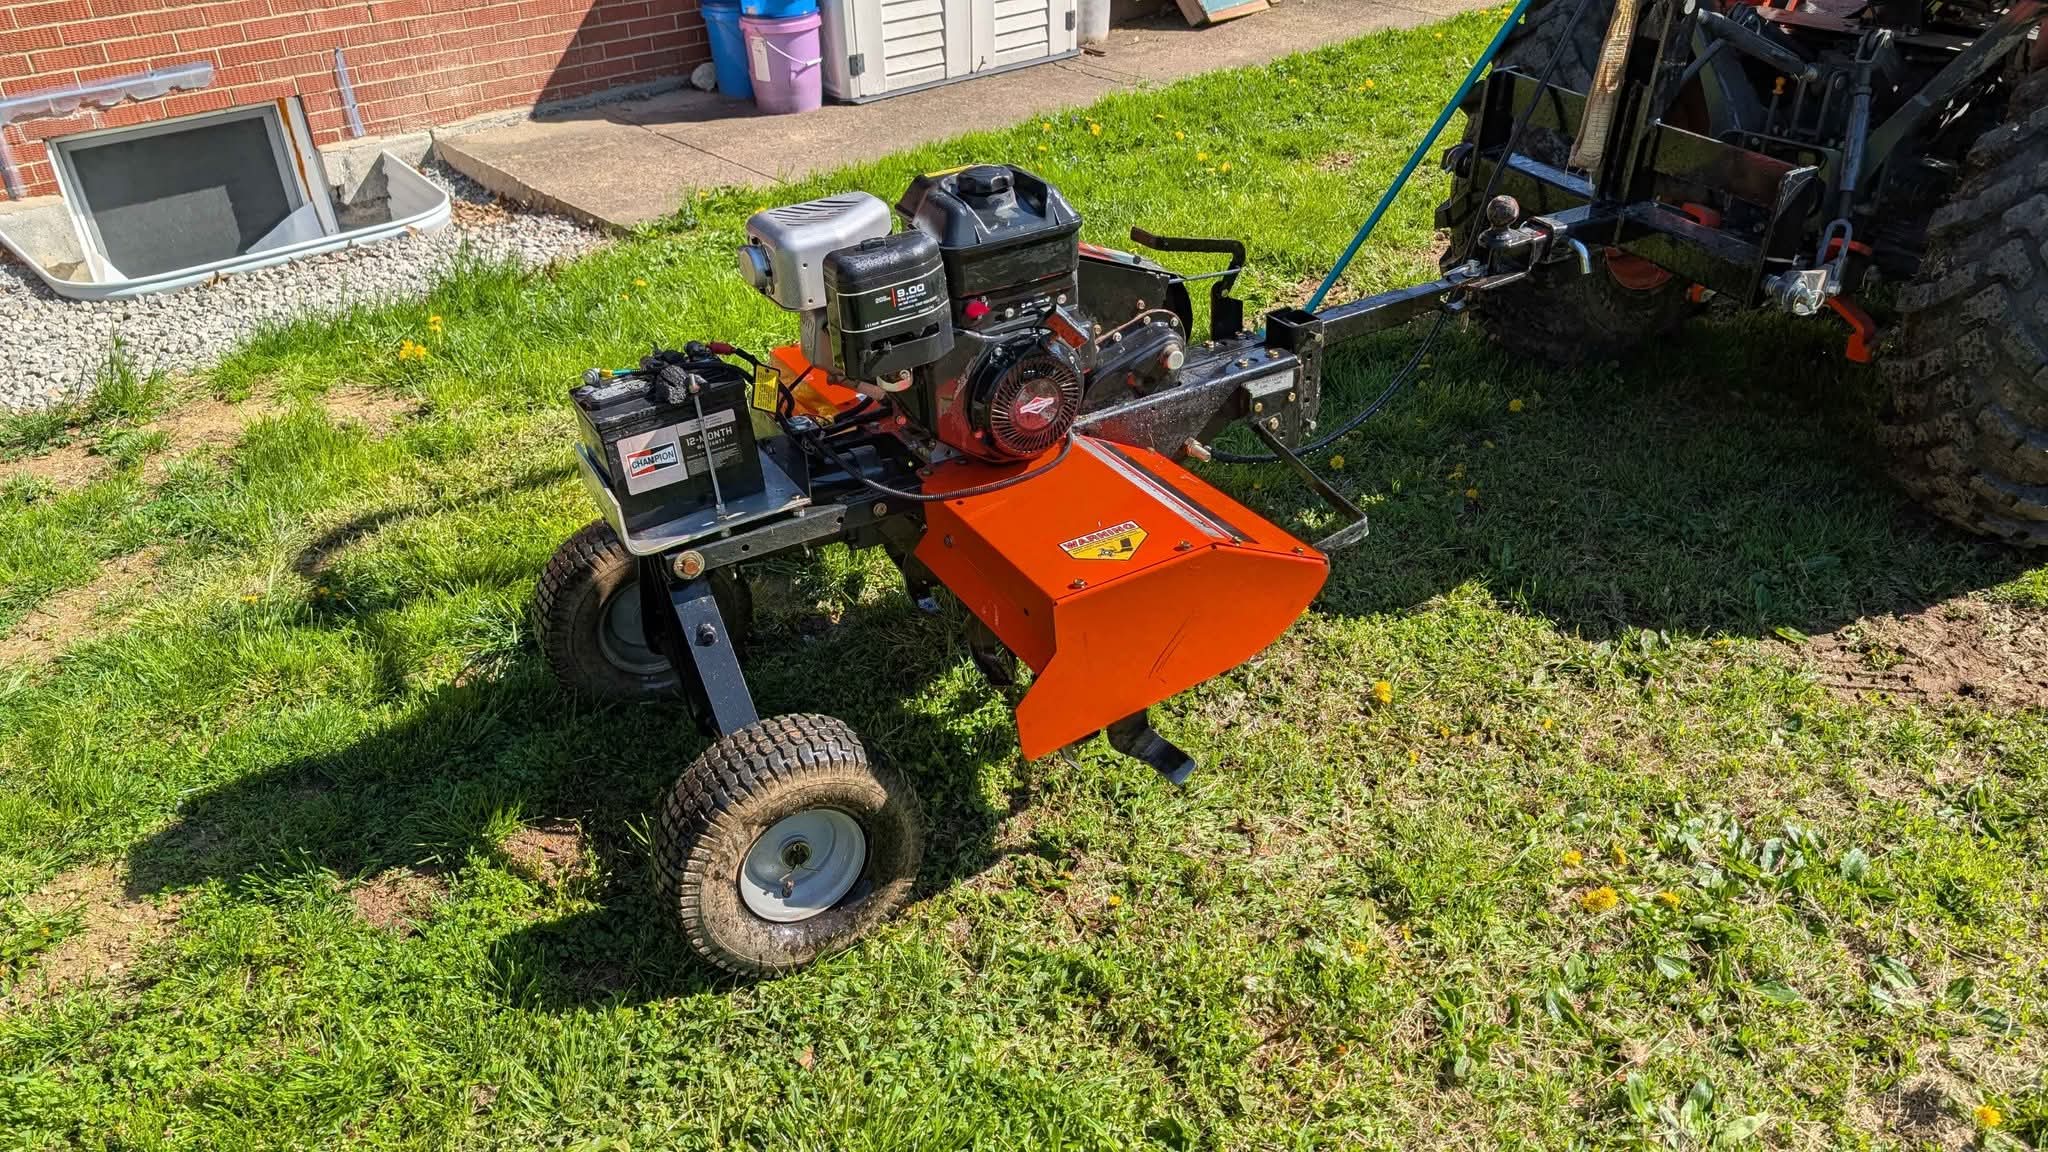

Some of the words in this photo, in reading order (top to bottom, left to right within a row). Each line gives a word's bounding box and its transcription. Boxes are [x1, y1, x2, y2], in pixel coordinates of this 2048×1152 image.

[897, 283, 925, 298] 9.00
[631, 450, 675, 470] CHAMPION
[1063, 523, 1137, 549] WARNING
